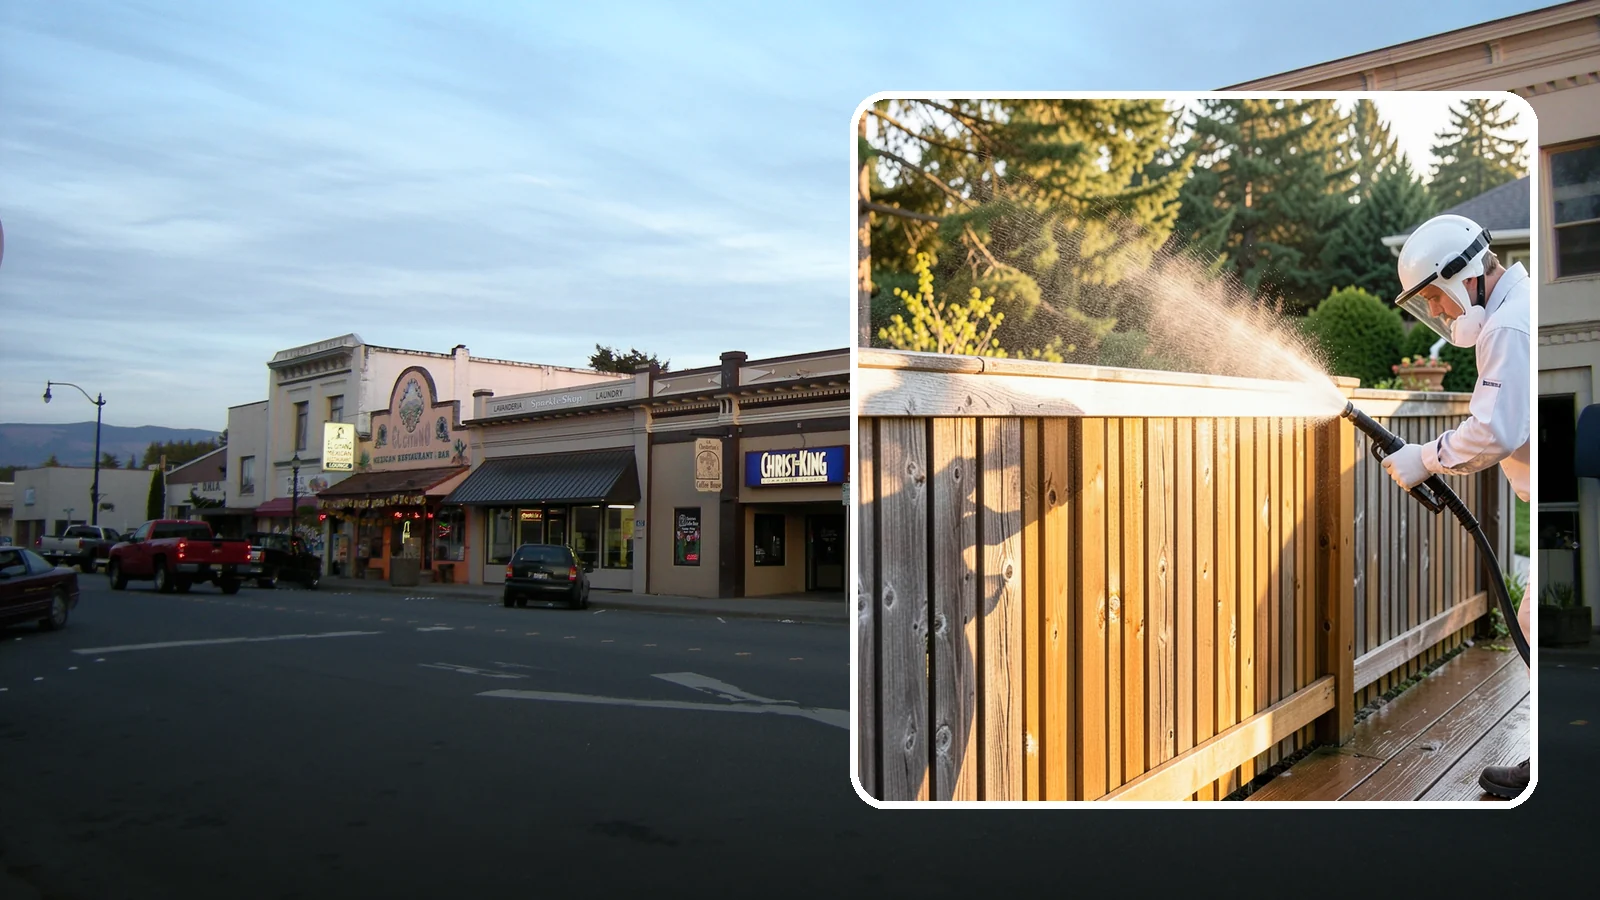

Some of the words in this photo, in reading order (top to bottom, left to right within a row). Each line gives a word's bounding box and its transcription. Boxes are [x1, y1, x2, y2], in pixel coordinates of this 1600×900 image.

[493, 402, 523, 412] LAVANDERIA
[530, 399, 560, 408] Sparkle
[562, 394, 583, 404] Shop
[595, 389, 624, 400] LAUNDRY
[373, 454, 396, 464] MEXICAN
[398, 451, 434, 462] RESTAURANT
[438, 450, 450, 459] BAR
[761, 452, 797, 478] CHRIST
[799, 450, 827, 476] KING
